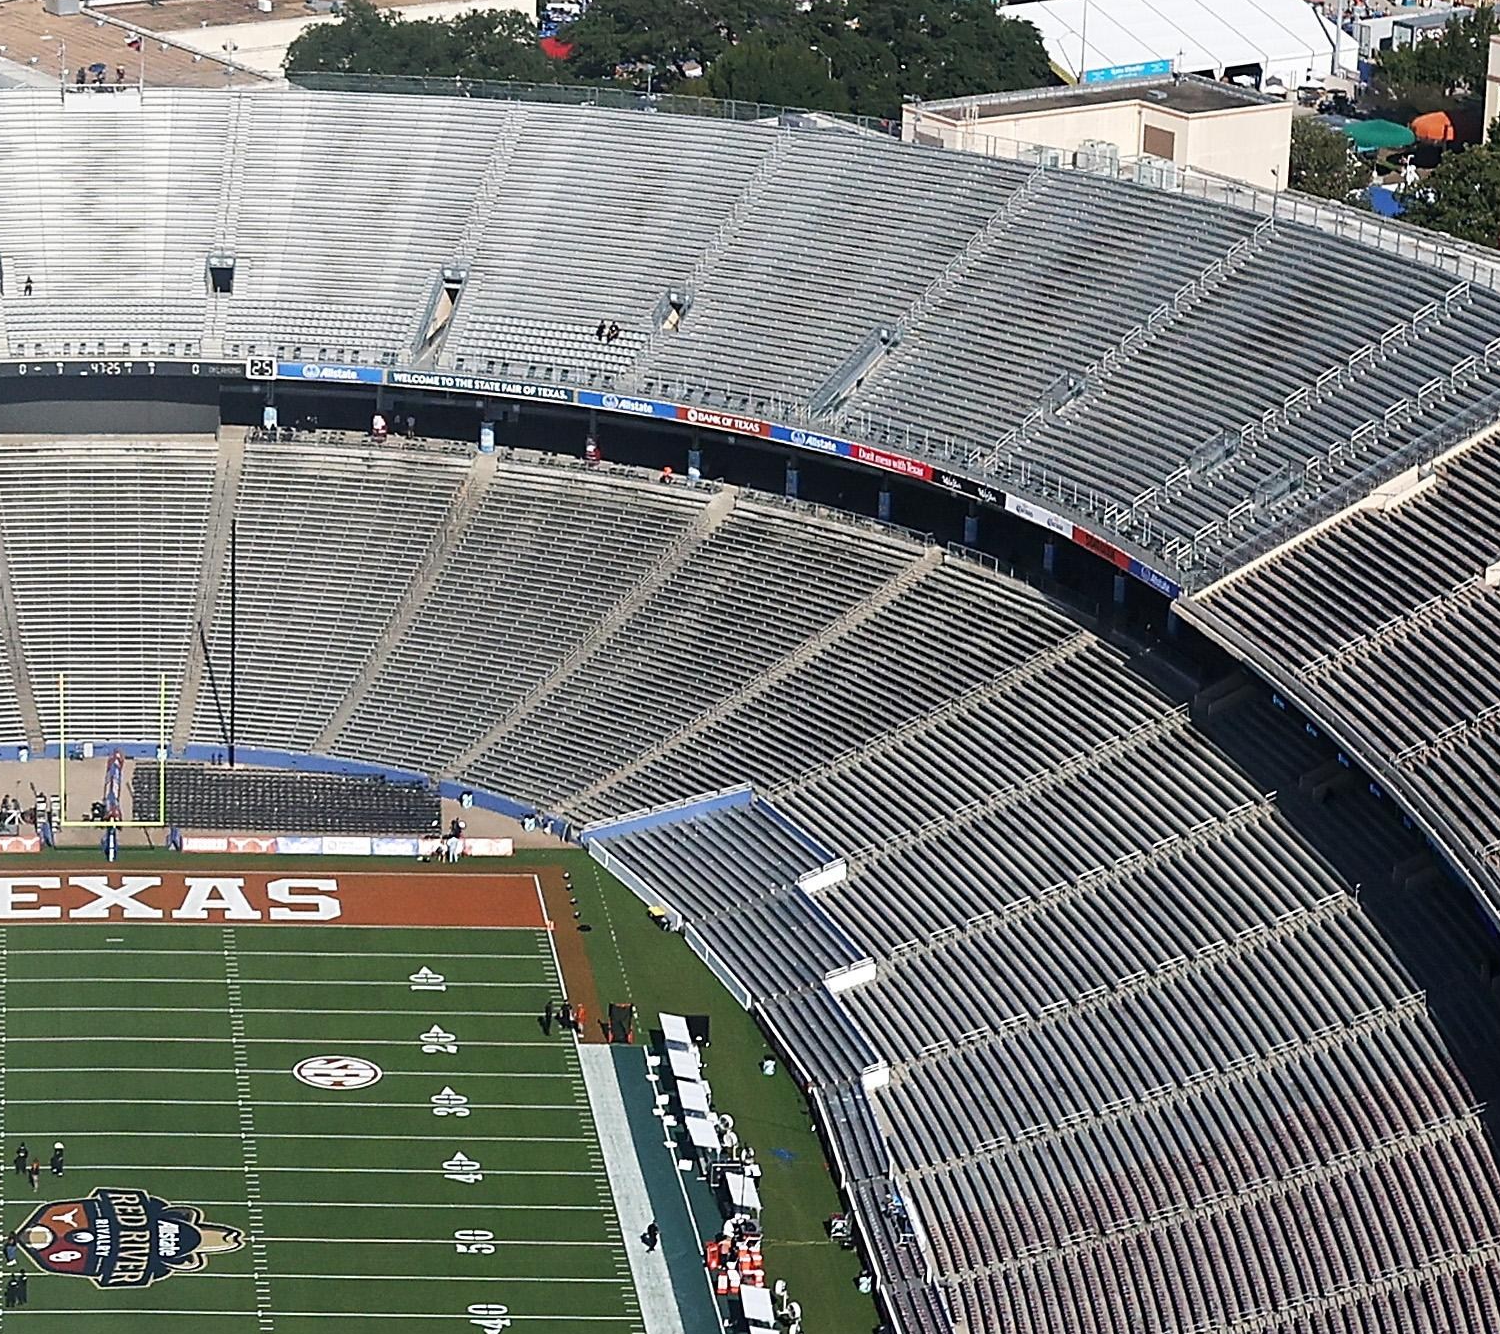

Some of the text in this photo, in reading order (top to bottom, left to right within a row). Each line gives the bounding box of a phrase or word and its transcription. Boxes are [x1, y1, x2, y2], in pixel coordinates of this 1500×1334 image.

[251, 360, 273, 375] 25
[320, 367, 357, 380] Allstate
[393, 373, 439, 386] WELCOME
[441, 377, 455, 387] TO
[456, 378, 473, 389] THE
[474, 379, 500, 392] STATE
[501, 382, 522, 394] FAIR
[523, 384, 537, 395] OF
[618, 399, 653, 413] Allstate
[698, 412, 760, 433] BANK OF TEXAS
[805, 436, 836, 452] Allstate
[409, 974, 447, 992] 10
[420, 1032, 457, 1053] 20
[431, 1094, 470, 1117] 30
[442, 1160, 483, 1183] 40
[95, 1218, 111, 1257] RIVALRY
[108, 1193, 150, 1284] RED RIVER
[158, 1220, 181, 1257] Allstate
[454, 1230, 495, 1254] 50
[467, 1304, 511, 1328] 40
